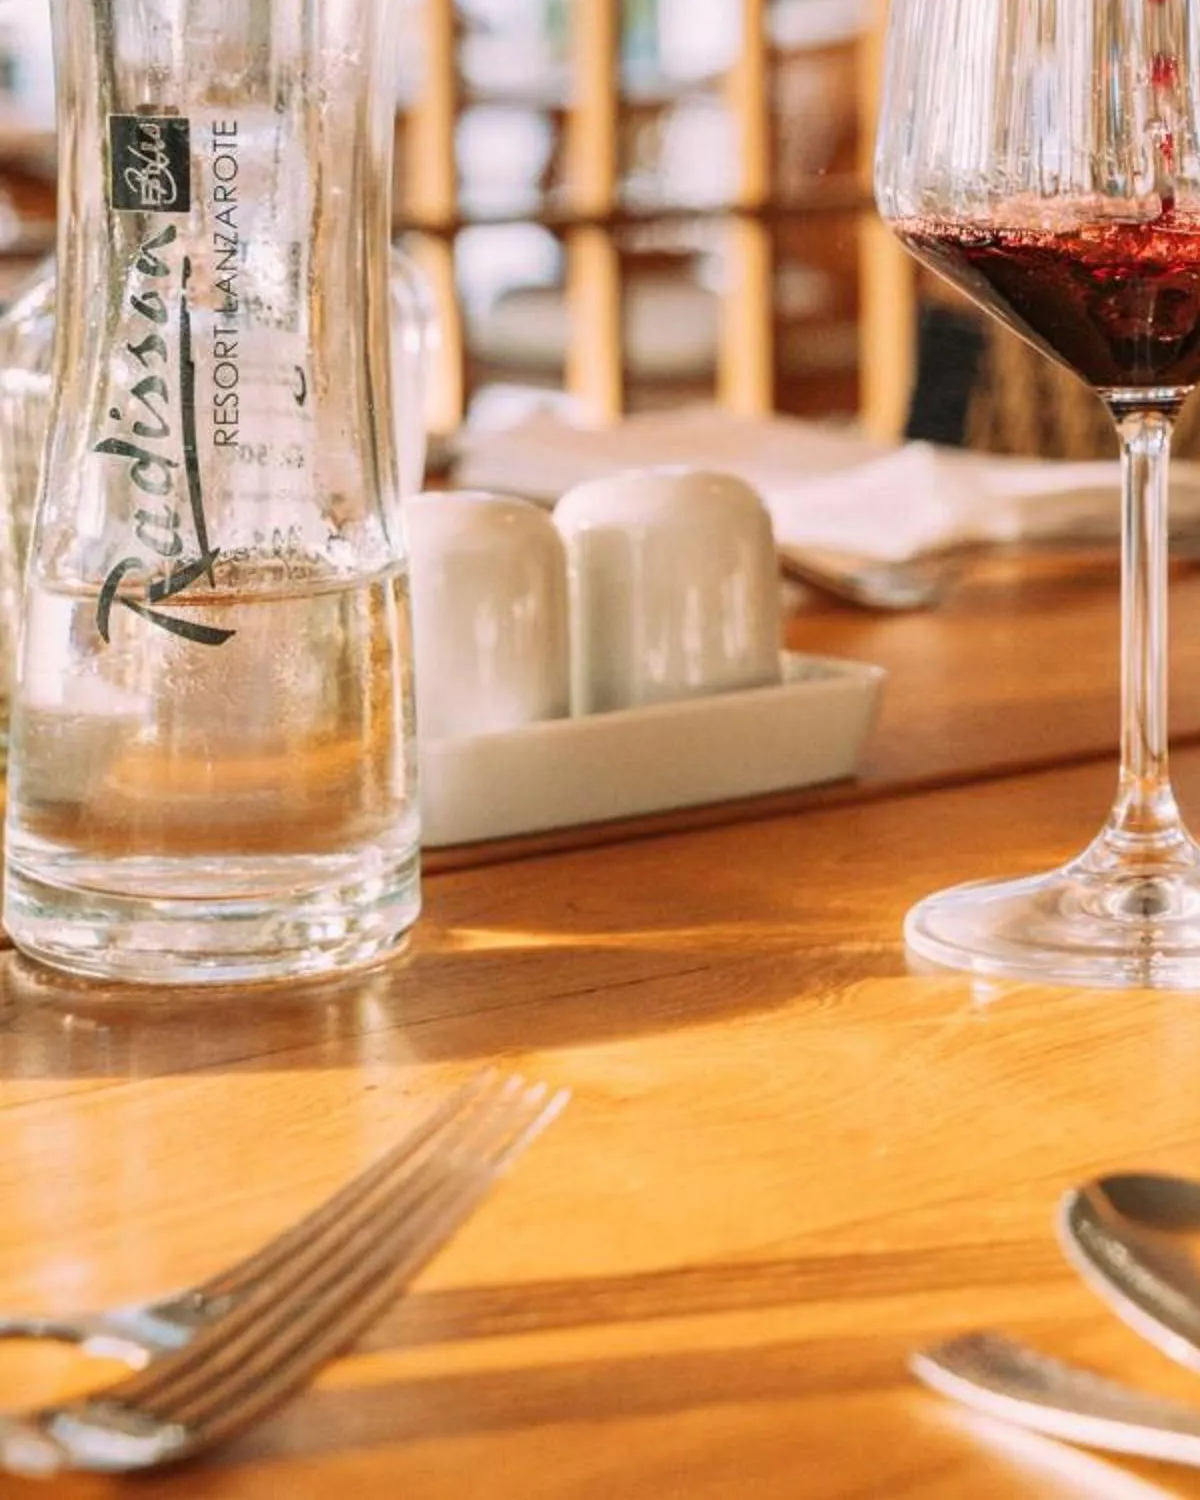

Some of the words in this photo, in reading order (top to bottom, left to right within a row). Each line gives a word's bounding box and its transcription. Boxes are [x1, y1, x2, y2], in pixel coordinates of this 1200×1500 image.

[212, 119, 239, 313] LANZAROTE
[95, 224, 235, 645] Radisson
[213, 317, 239, 449] RESORT
